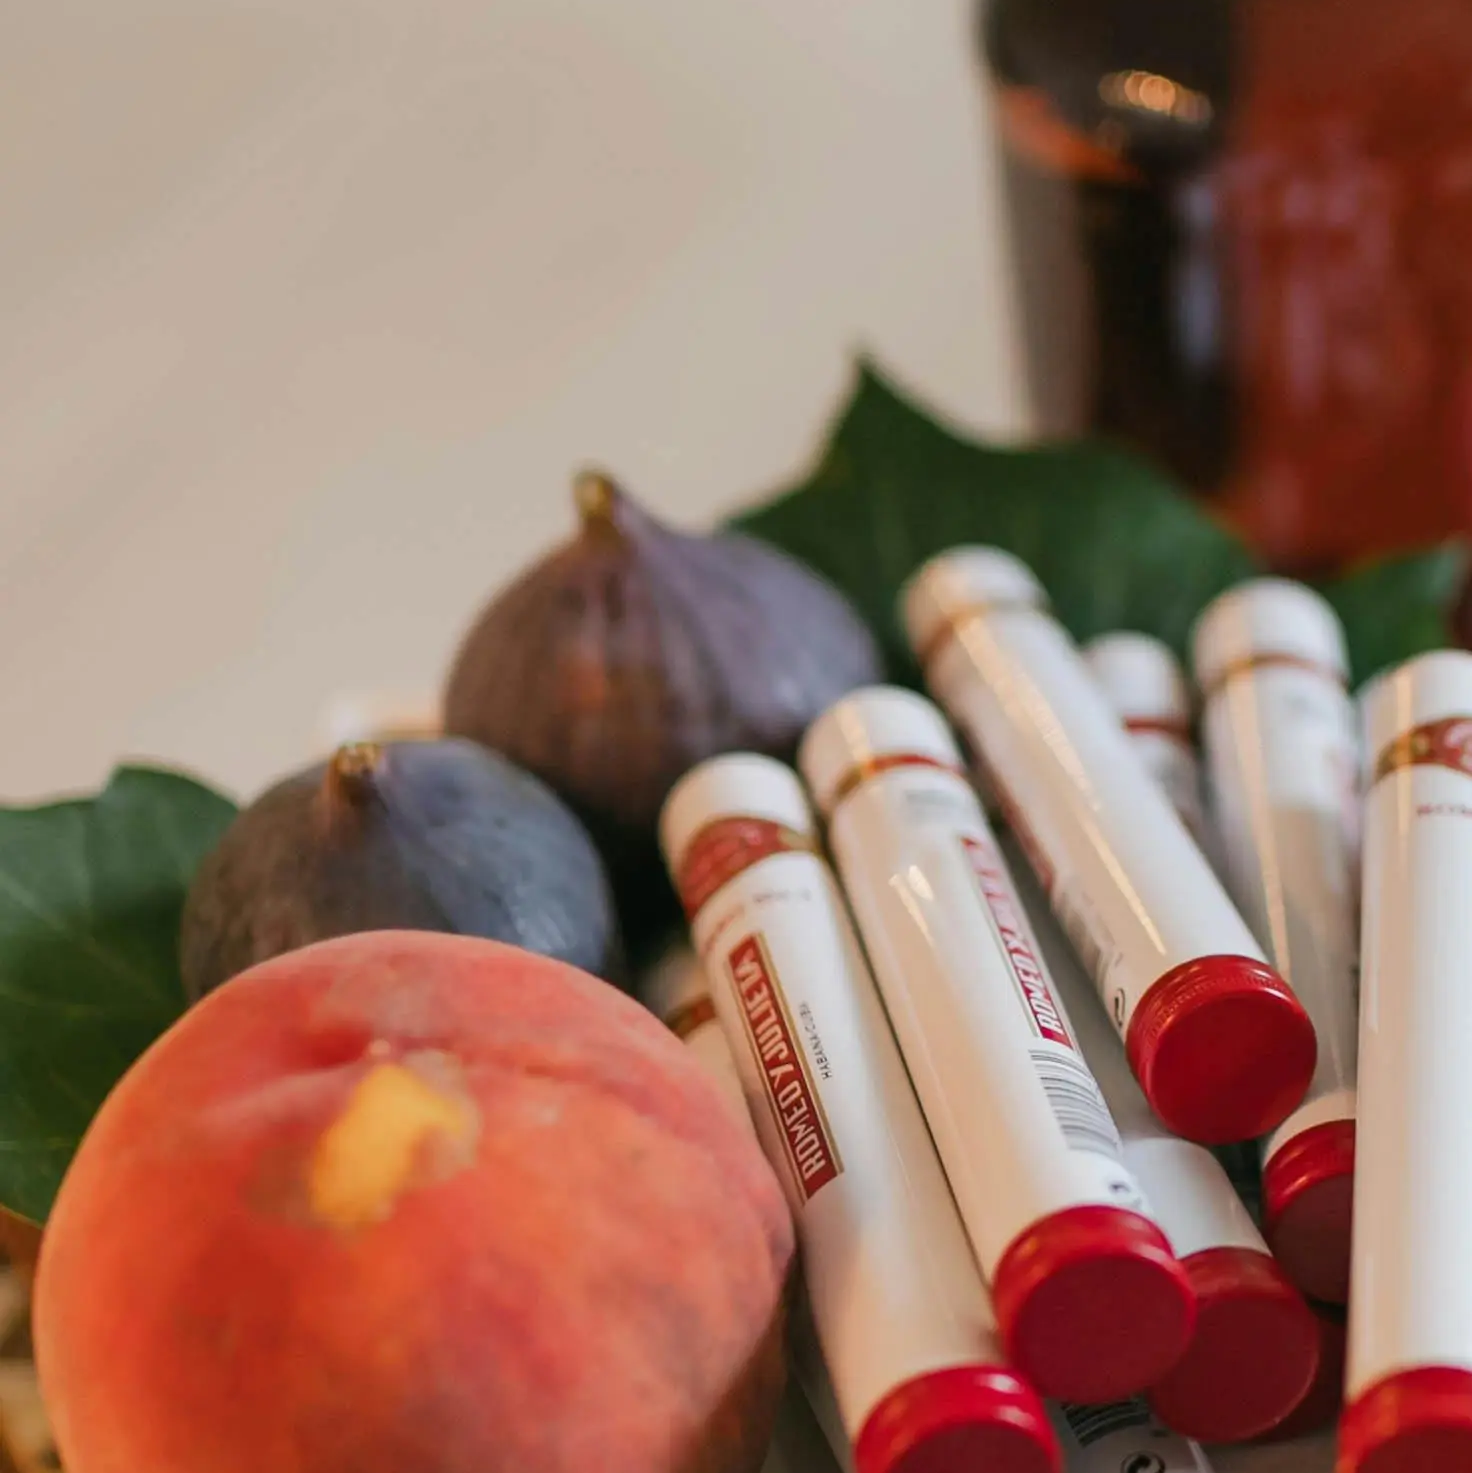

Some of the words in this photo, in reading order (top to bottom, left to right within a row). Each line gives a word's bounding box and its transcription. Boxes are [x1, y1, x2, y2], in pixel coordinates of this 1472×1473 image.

[734, 948, 789, 1062] JULIETA
[769, 1063, 795, 1089] Y
[778, 1080, 826, 1181] ROMEO
